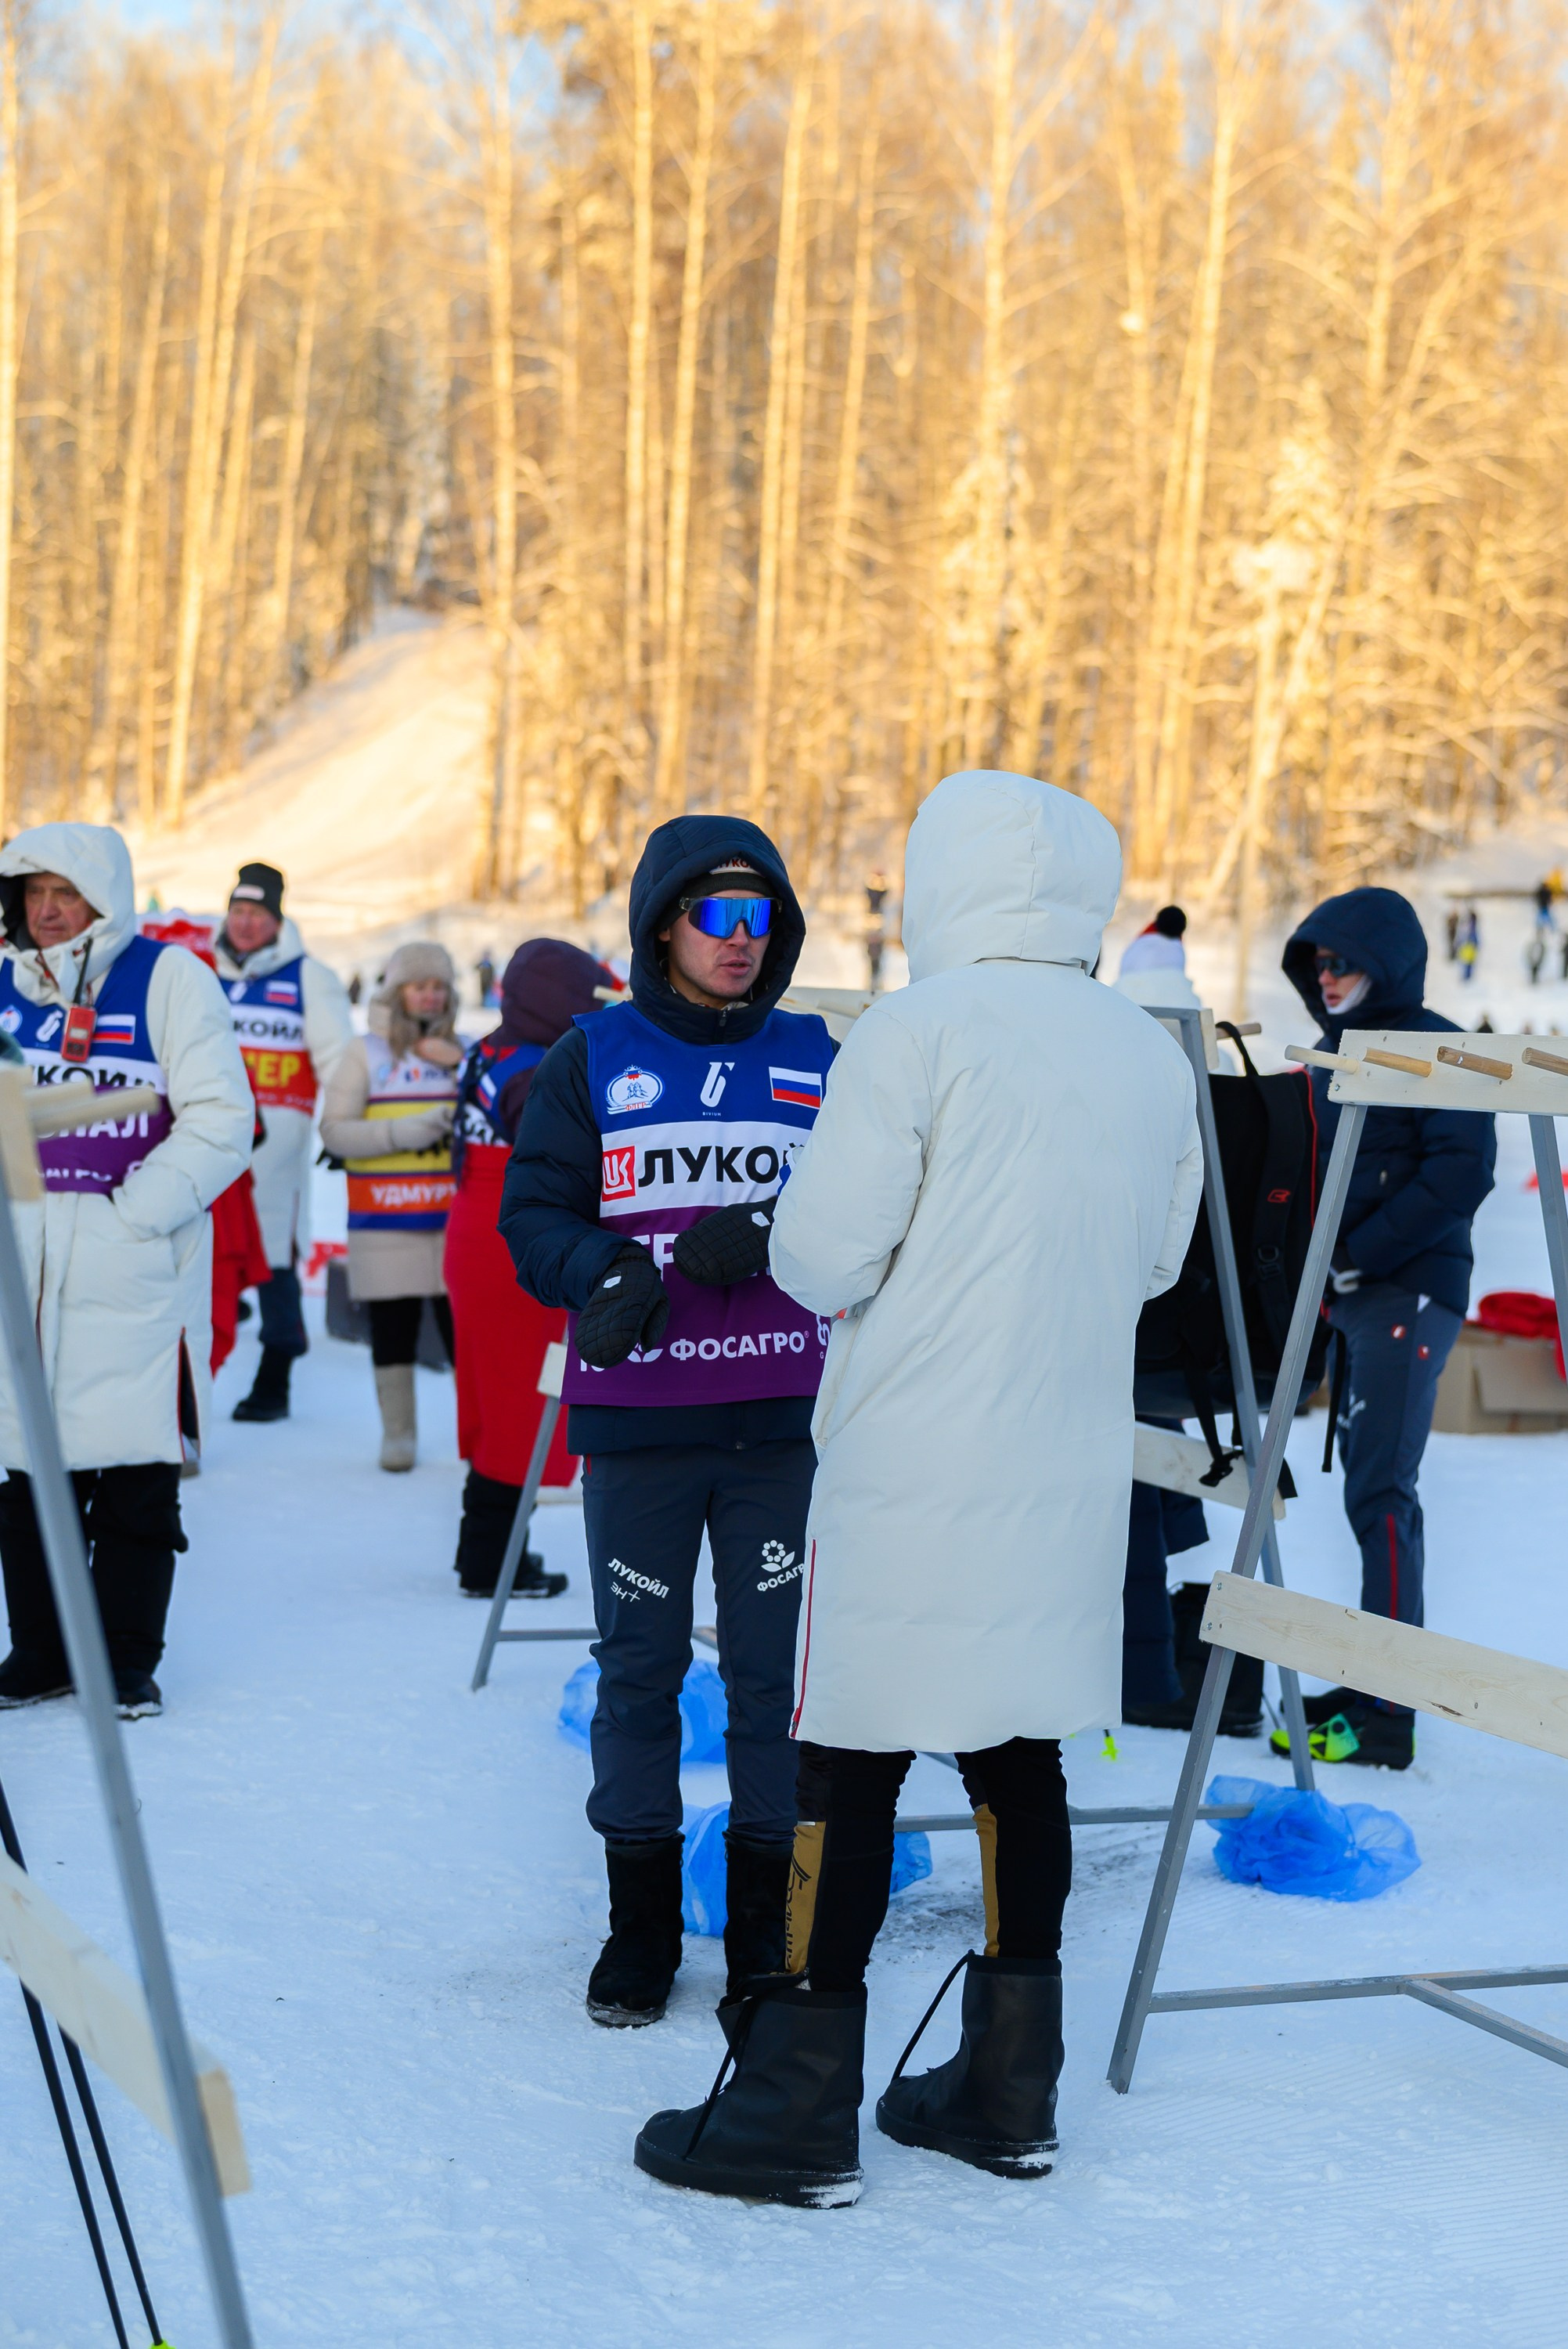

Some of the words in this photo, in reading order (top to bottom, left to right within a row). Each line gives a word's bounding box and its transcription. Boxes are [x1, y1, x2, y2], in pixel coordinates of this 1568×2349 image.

[625, 1102, 647, 1110] ФЛГР
[638, 1142, 805, 1187] ЛУКО
[607, 1557, 669, 1599] ЛУКОЙЛ
